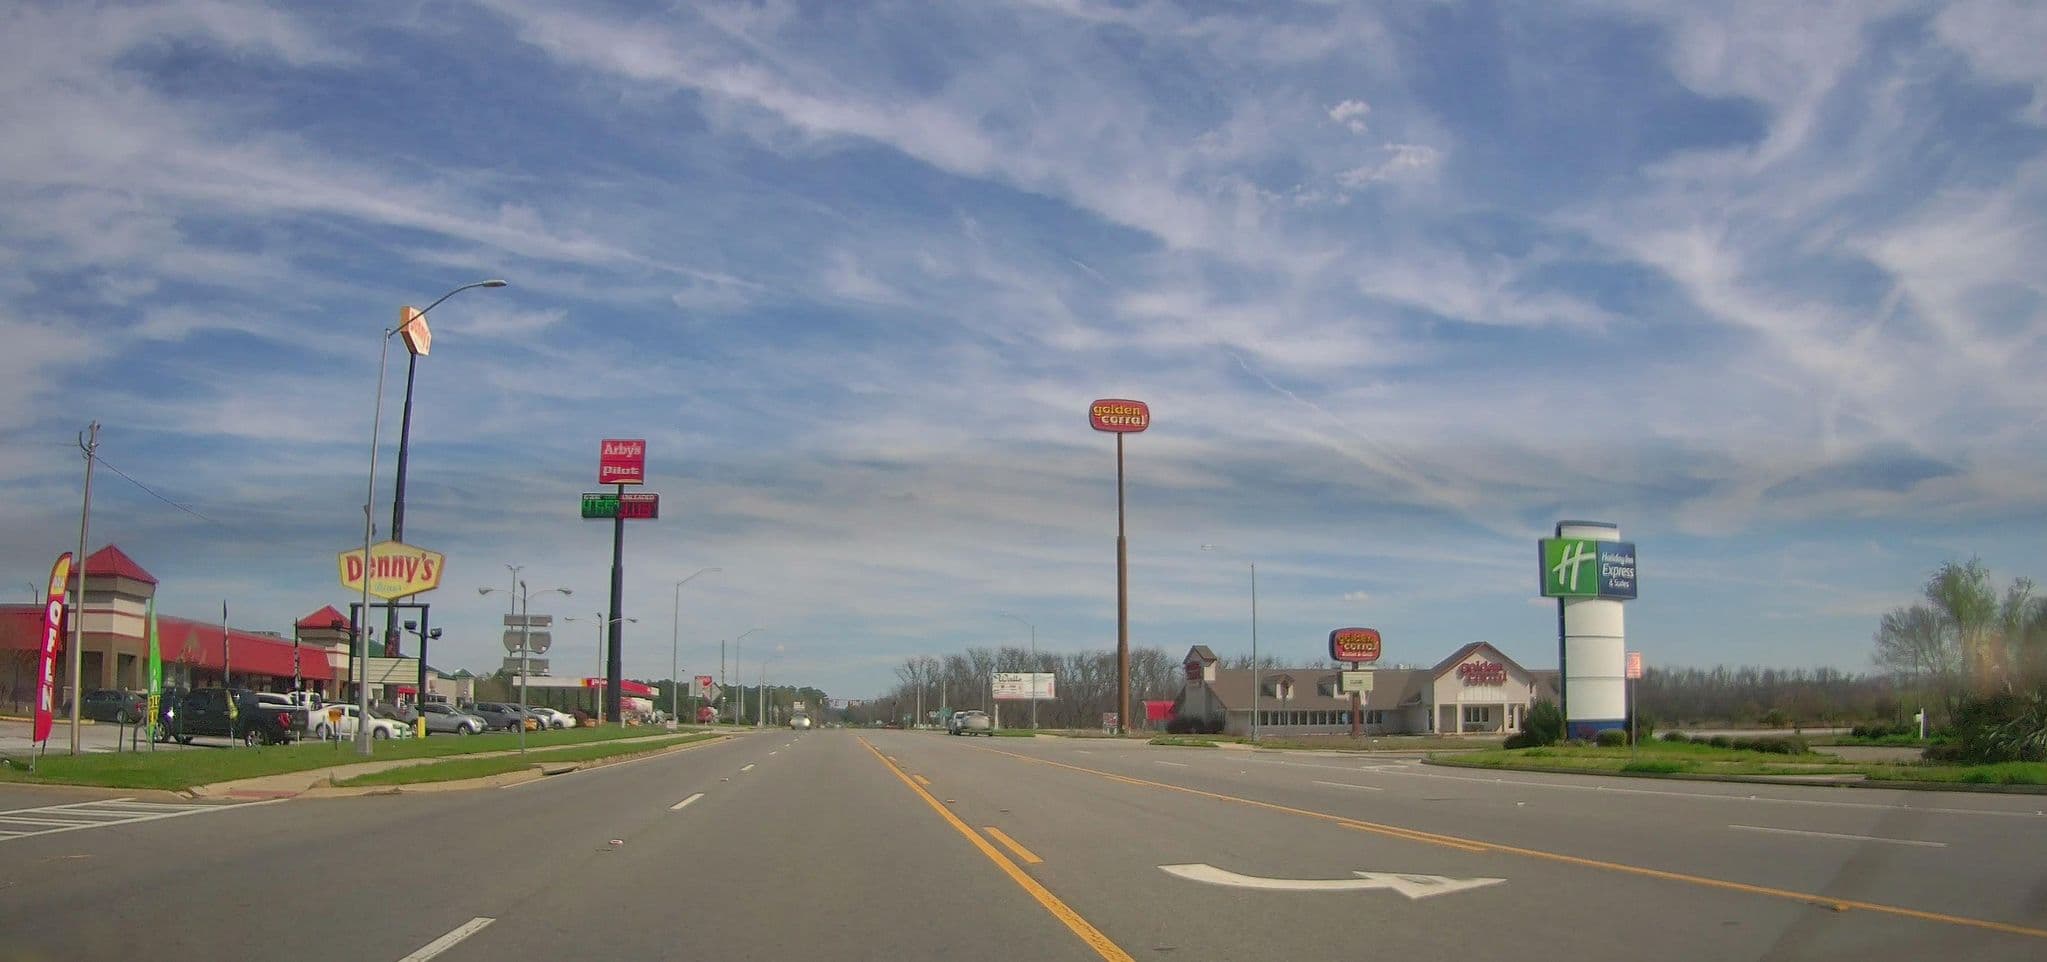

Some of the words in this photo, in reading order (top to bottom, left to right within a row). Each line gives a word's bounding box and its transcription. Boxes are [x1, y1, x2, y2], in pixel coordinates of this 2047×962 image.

[1094, 405, 1140, 416] golden
[1101, 415, 1145, 425] corral
[603, 443, 641, 457] Arby's
[1601, 551, 1624, 565] Holiday
[346, 552, 435, 584] Denny's
[1603, 563, 1634, 578] Express
[42, 600, 62, 713] OPEN
